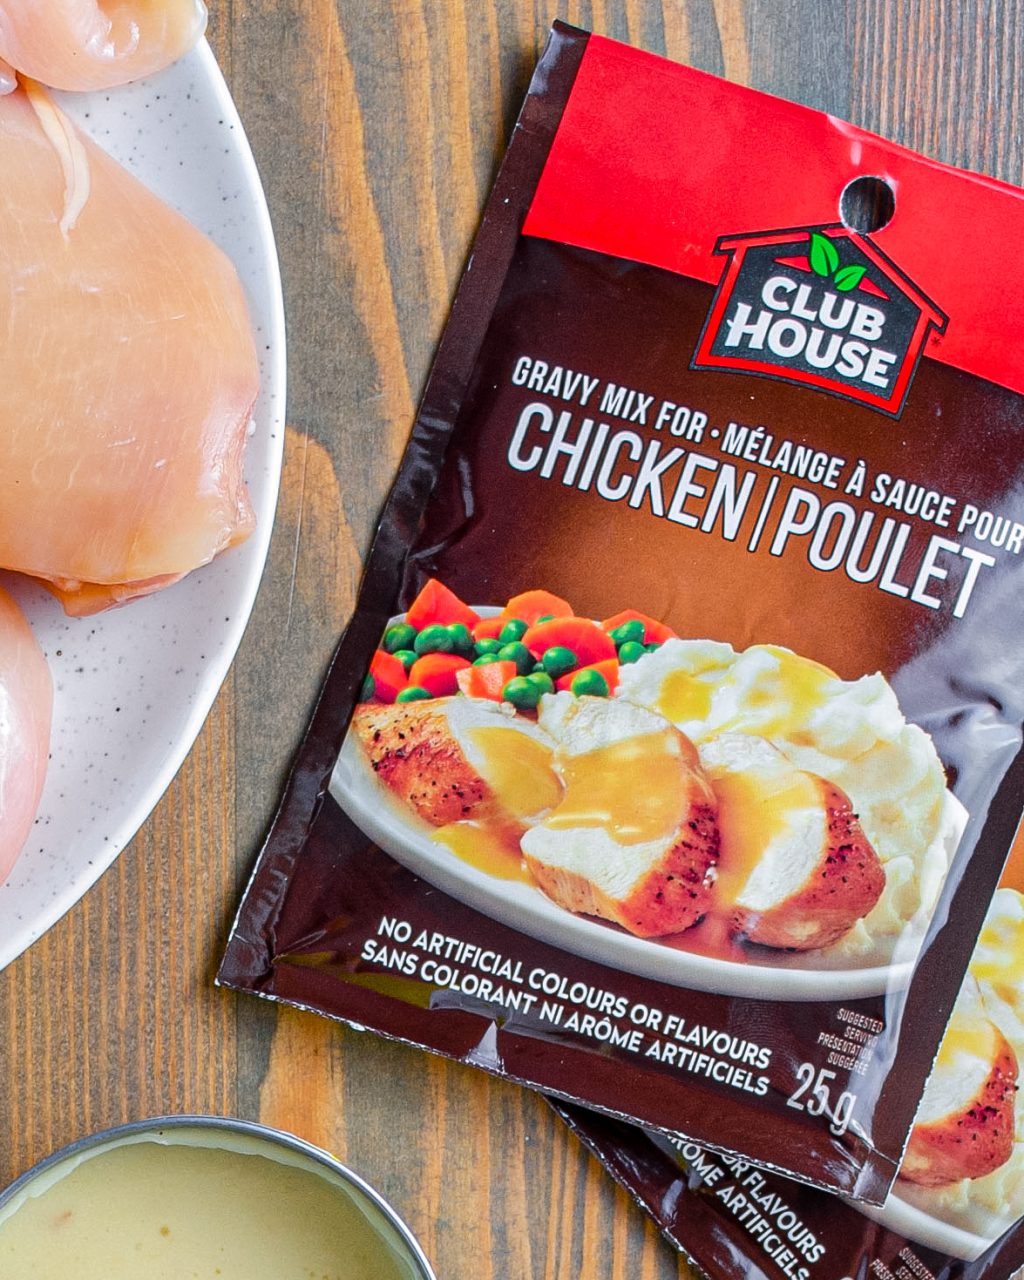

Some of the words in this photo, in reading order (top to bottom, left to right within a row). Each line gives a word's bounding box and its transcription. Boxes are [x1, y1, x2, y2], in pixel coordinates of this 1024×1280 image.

[725, 302, 898, 388] HOUSE
[762, 276, 886, 341] CLUB
[507, 402, 757, 541] CHICKEN
[770, 486, 996, 619] POULET
[511, 356, 599, 406] GRAVY
[599, 383, 655, 425] MIX
[655, 401, 708, 443] FOR
[721, 422, 845, 489] MÉLANGE
[844, 459, 866, 497] À
[870, 473, 957, 528] SAUCE
[957, 504, 1024, 554] POUR
[361, 939, 419, 975] SANS
[420, 960, 538, 1014] COLORANT
[539, 1000, 564, 1026] NI
[564, 1011, 644, 1052] ARÔME
[645, 1039, 770, 1096] ARTIFICIELS
[377, 916, 412, 943] NO
[412, 930, 524, 984] ARTIFICIAL
[528, 968, 629, 1018] COLOURS
[630, 1004, 663, 1031] OR
[663, 1015, 773, 1069] FLAVOURS
[837, 1008, 884, 1034] SUGGESTED
[742, 1171, 825, 1263] FLAVOURS
